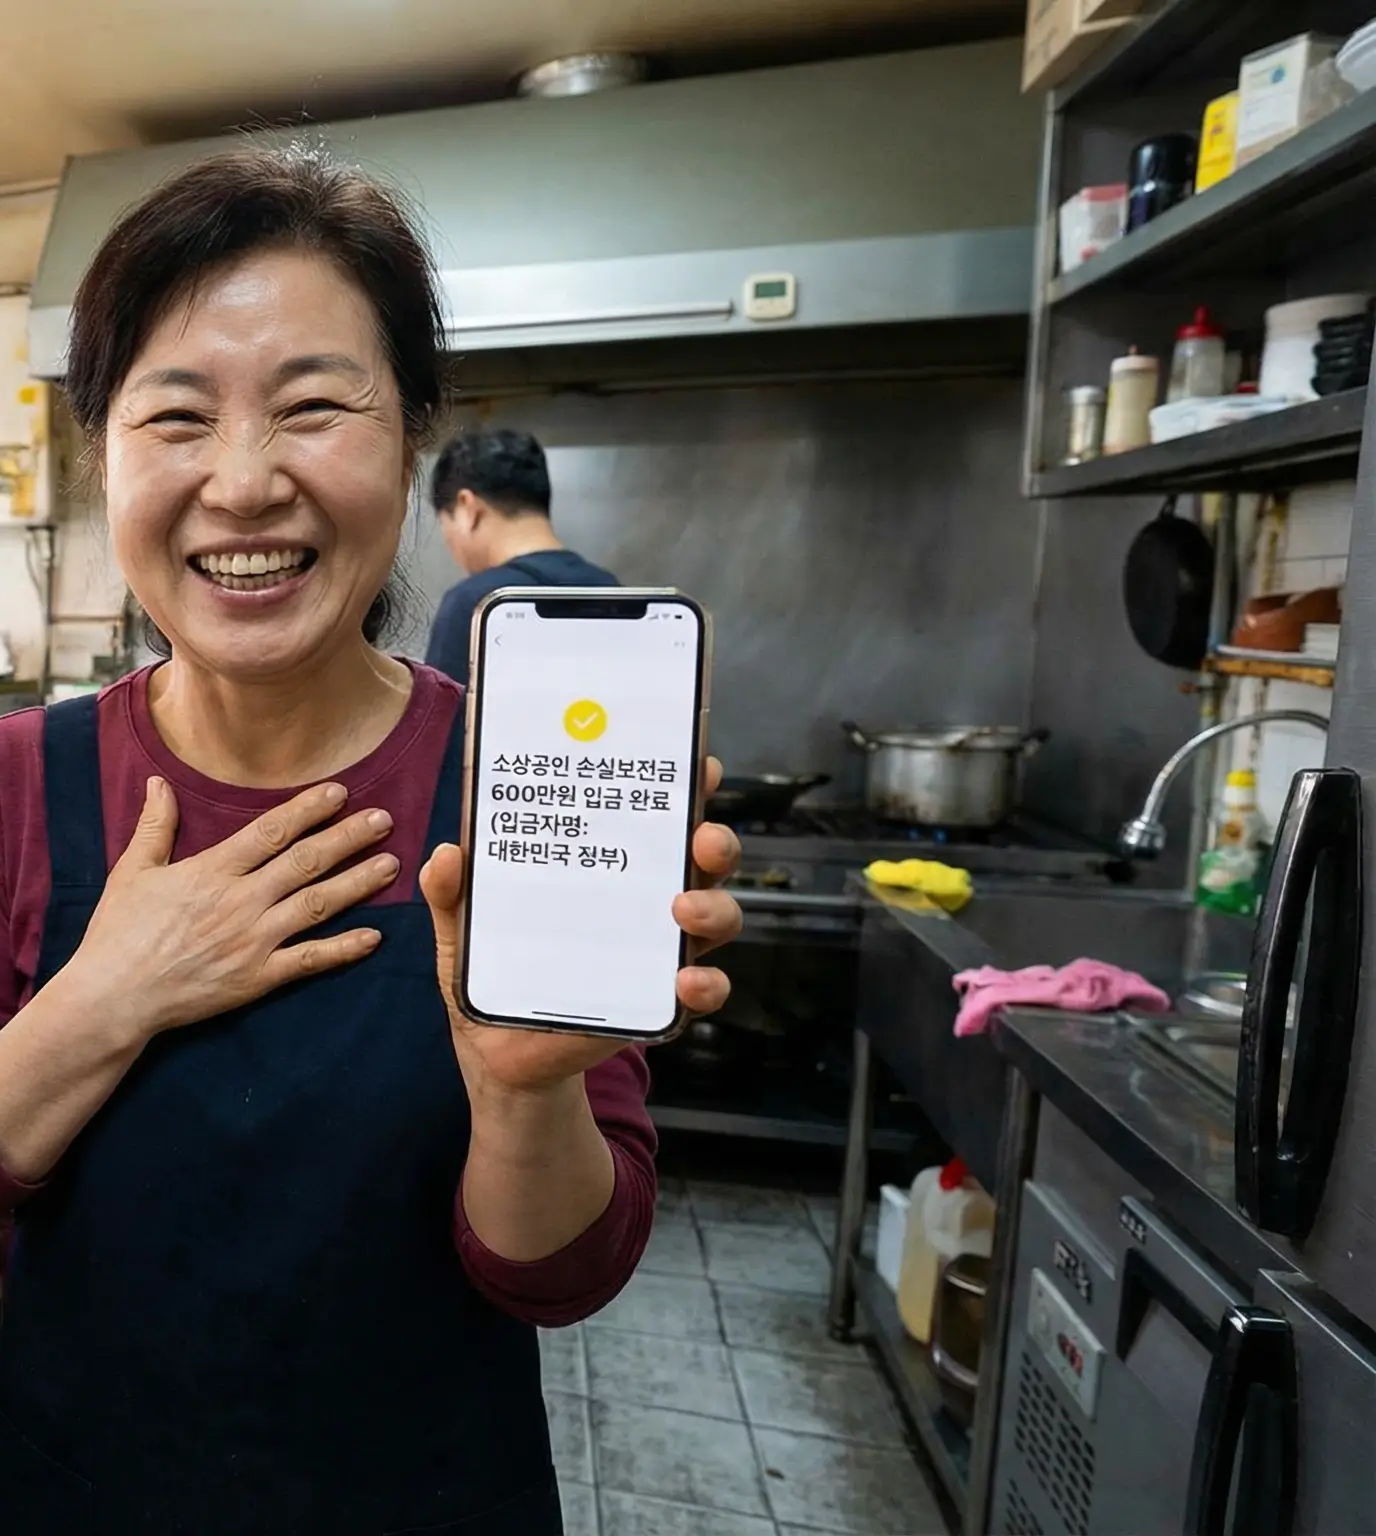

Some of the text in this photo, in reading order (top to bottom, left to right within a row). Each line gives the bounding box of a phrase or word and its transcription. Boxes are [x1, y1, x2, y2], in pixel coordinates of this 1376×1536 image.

[491, 753, 678, 783] 소상공인 손실보전금
[491, 783, 671, 812] 600만원 입금 완료
[490, 811, 589, 838] (입금자명:
[488, 839, 628, 873] 대한민국 정부)
